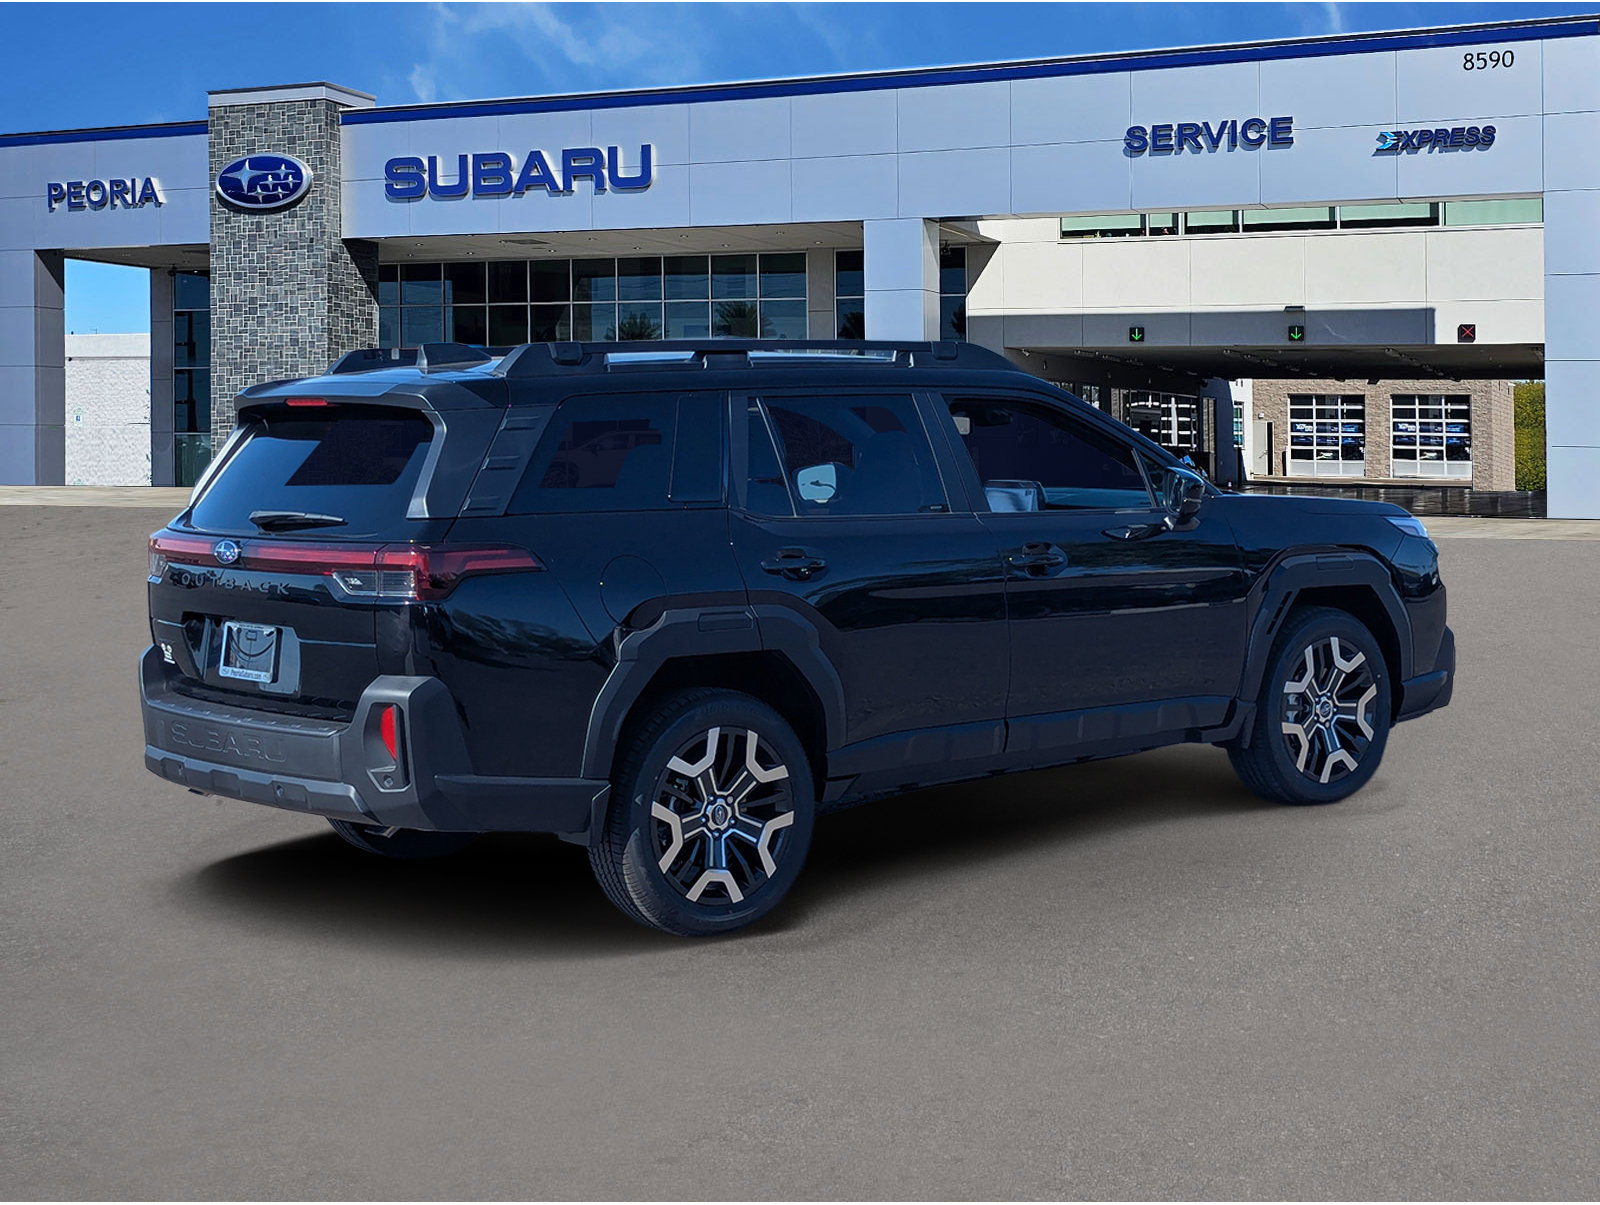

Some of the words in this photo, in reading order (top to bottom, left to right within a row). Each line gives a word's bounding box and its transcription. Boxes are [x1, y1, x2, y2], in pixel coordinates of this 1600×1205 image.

[1463, 50, 1515, 71] 8590
[1125, 116, 1294, 152] SERVICE
[1376, 125, 1497, 151] EXPRESS
[384, 143, 652, 199] SUBARU
[47, 177, 160, 210] PEORIA
[181, 572, 290, 595] OUTBACK
[171, 719, 286, 763] SUBARU
